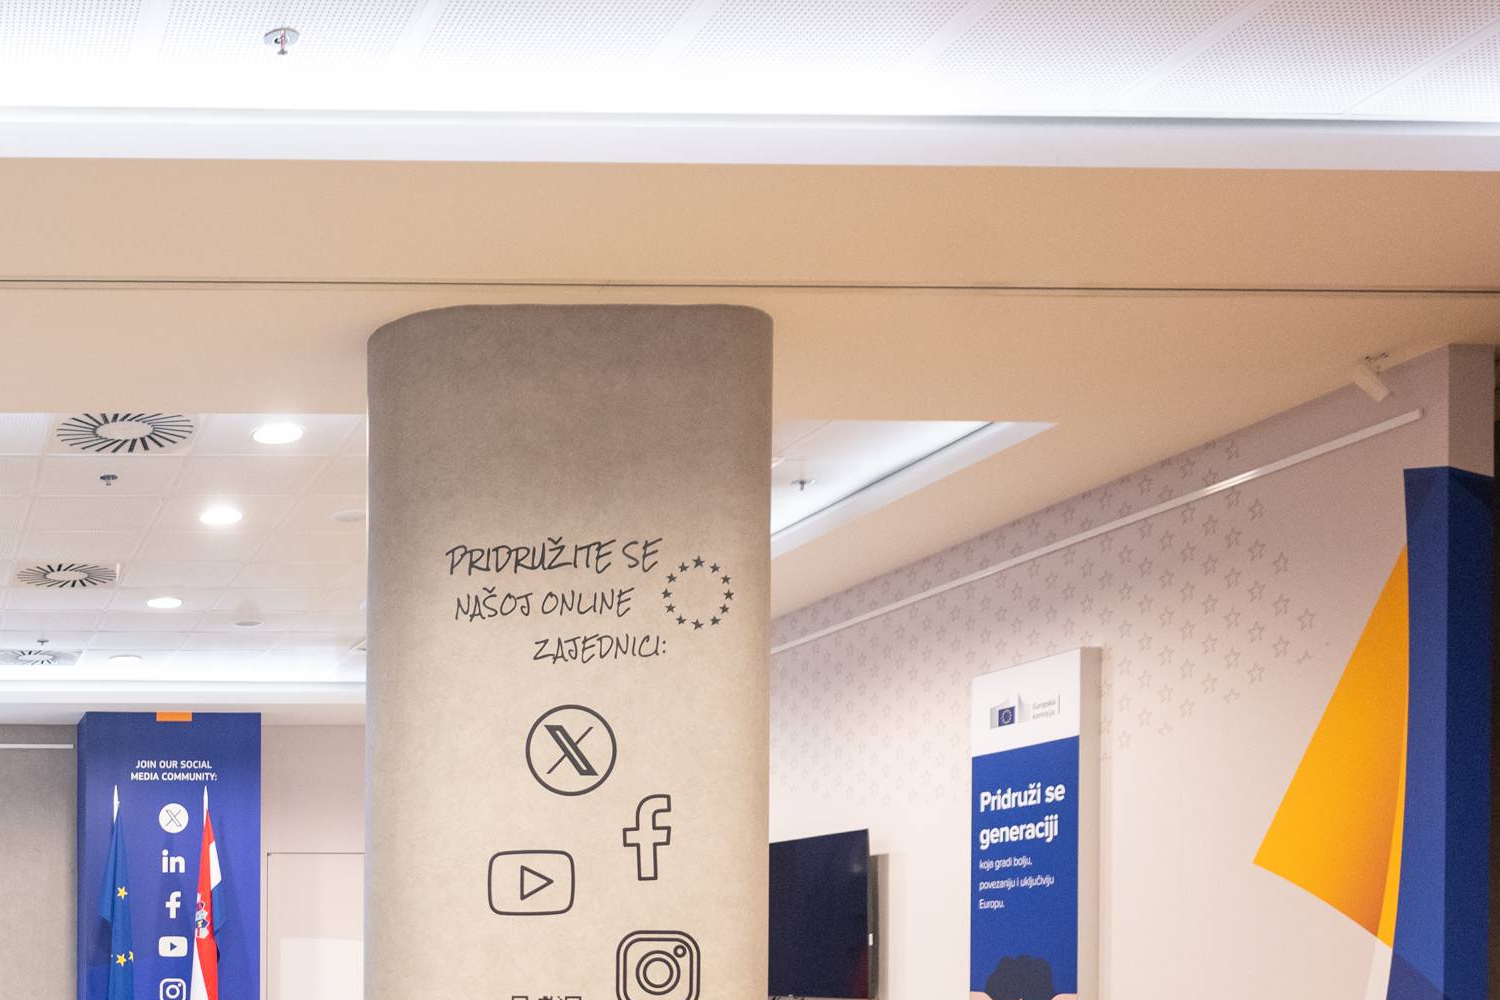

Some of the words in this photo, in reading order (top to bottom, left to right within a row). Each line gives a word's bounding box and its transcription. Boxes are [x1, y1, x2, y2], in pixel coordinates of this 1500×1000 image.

[445, 536, 617, 576] PRIDRUŽITE
[621, 537, 663, 573] SE
[454, 586, 534, 622] NAŠOJ
[541, 587, 635, 618] ONLINE
[533, 633, 667, 665] ZAJEDNICI:
[130, 772, 159, 781] MEDIA
[161, 772, 218, 781] COMMUNITY:
[135, 760, 157, 769] JOIN
[159, 760, 178, 769] OUR
[180, 760, 212, 769] SOCIAL
[980, 782, 1041, 812] Pridruži
[1045, 783, 1066, 803] se
[979, 815, 1059, 850] generaciji
